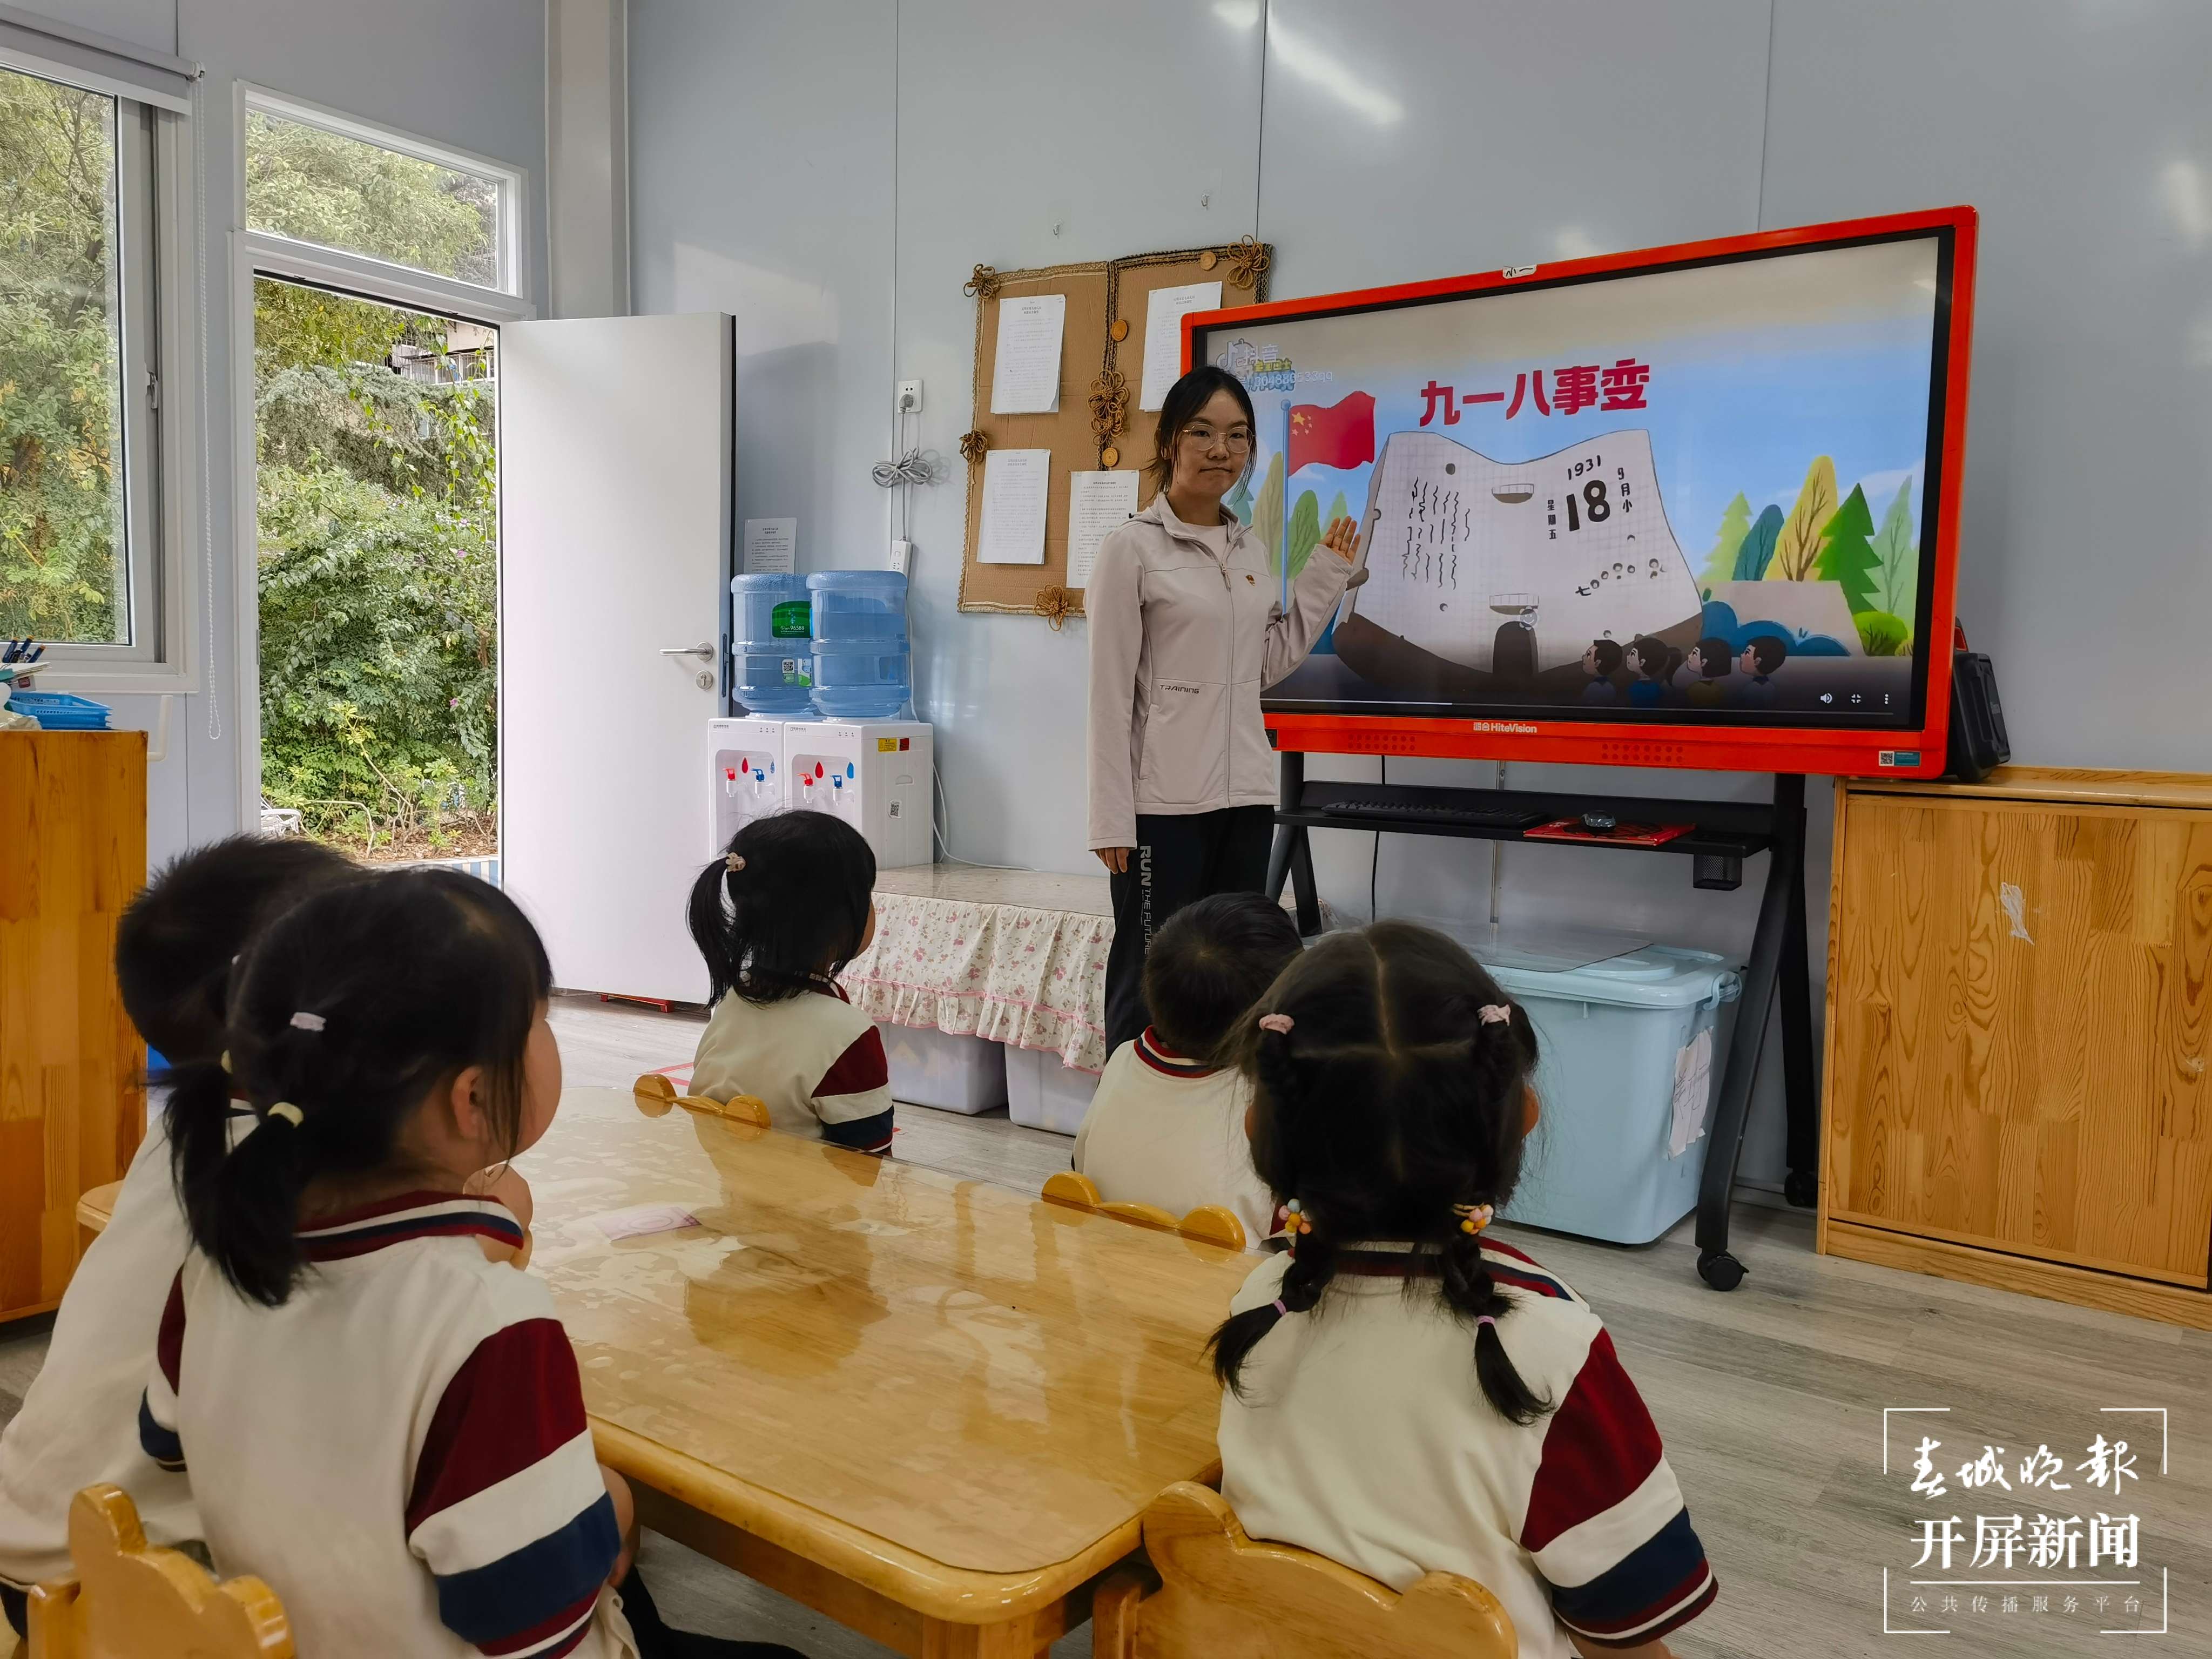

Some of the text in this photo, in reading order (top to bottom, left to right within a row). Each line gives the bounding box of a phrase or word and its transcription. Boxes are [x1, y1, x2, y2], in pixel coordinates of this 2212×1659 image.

[1419, 358, 1650, 427] 九一八事变
[1568, 455, 1601, 481] 1931
[1566, 480, 1610, 532] 18
[1159, 684, 1199, 694] TRAINING
[1491, 723, 1537, 733] HiteVision
[1139, 845, 1151, 886] RUN
